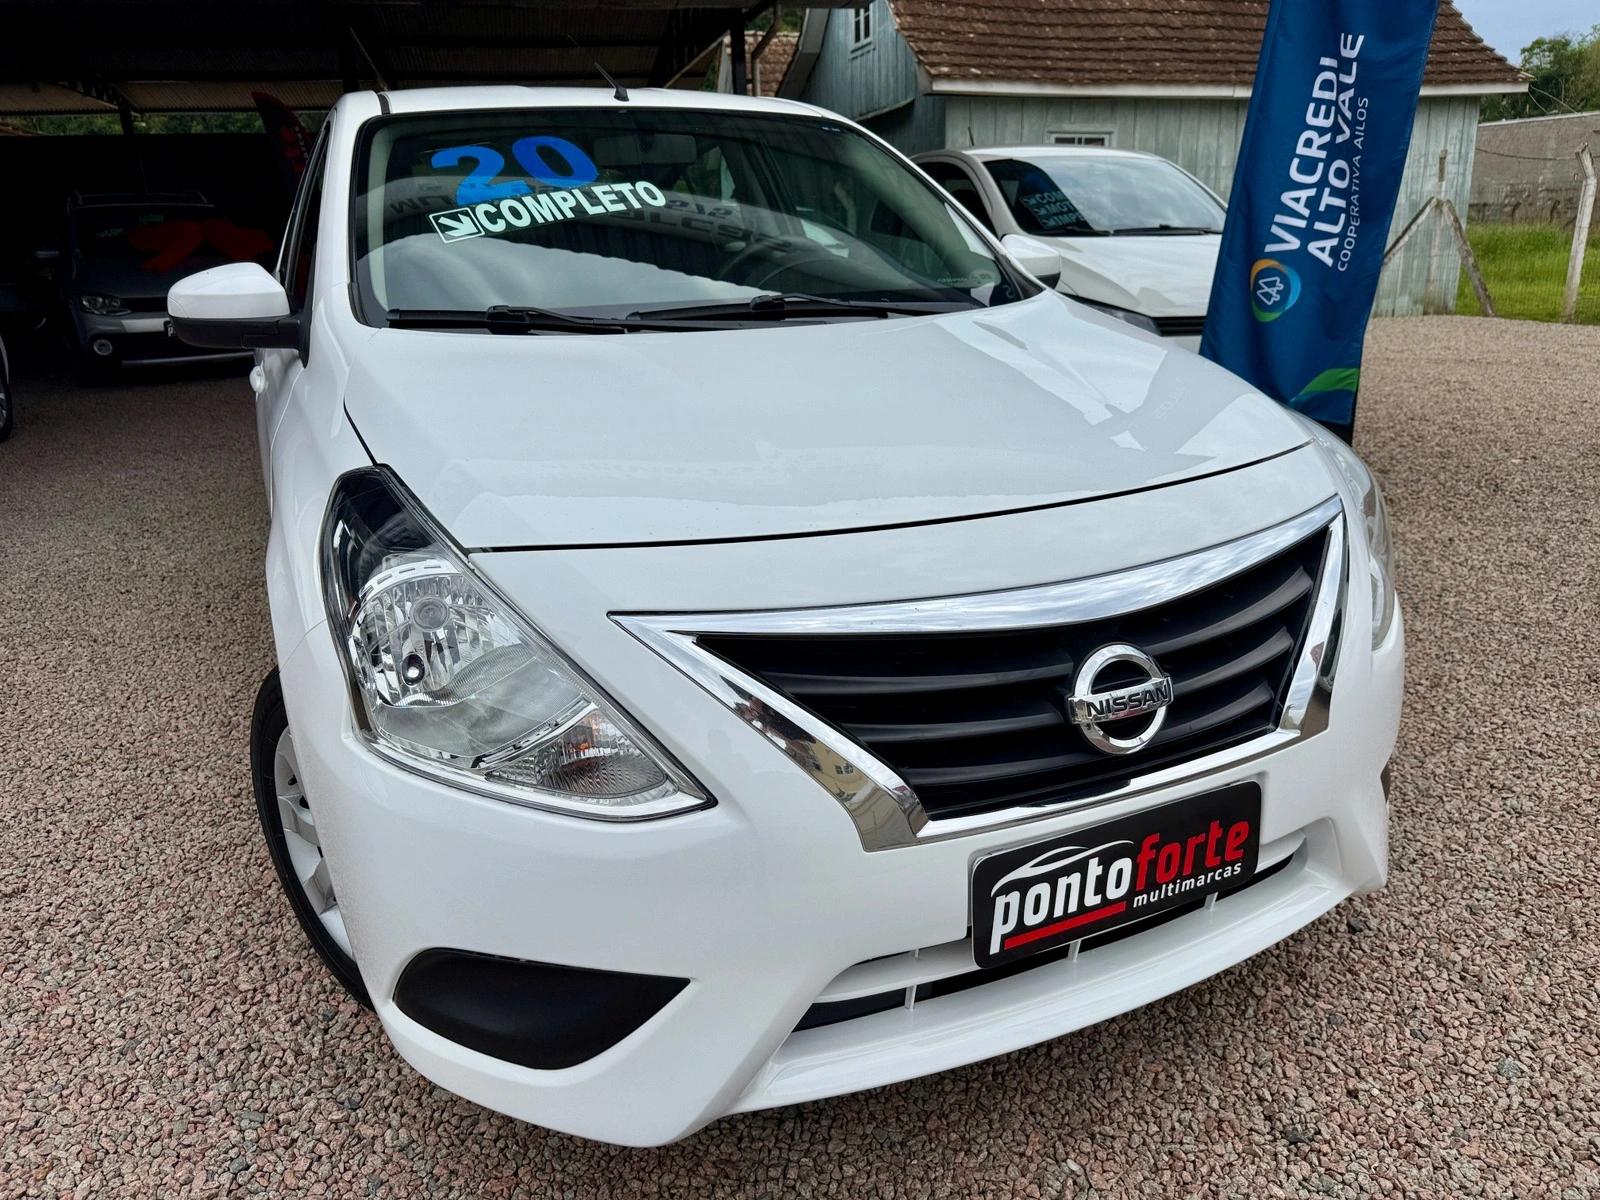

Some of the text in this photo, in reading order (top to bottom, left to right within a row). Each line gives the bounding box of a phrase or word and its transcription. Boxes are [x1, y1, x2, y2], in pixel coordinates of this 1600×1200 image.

[431, 135, 599, 207] 20
[1264, 56, 1338, 254] VIACREDI
[1307, 32, 1365, 268] ALTO VALE
[1337, 97, 1369, 272] COOPERATIVA AILOS
[474, 180, 667, 232] COMPLETO
[1086, 685, 1168, 718] NISSAN
[1133, 861, 1242, 908] multimarcas
